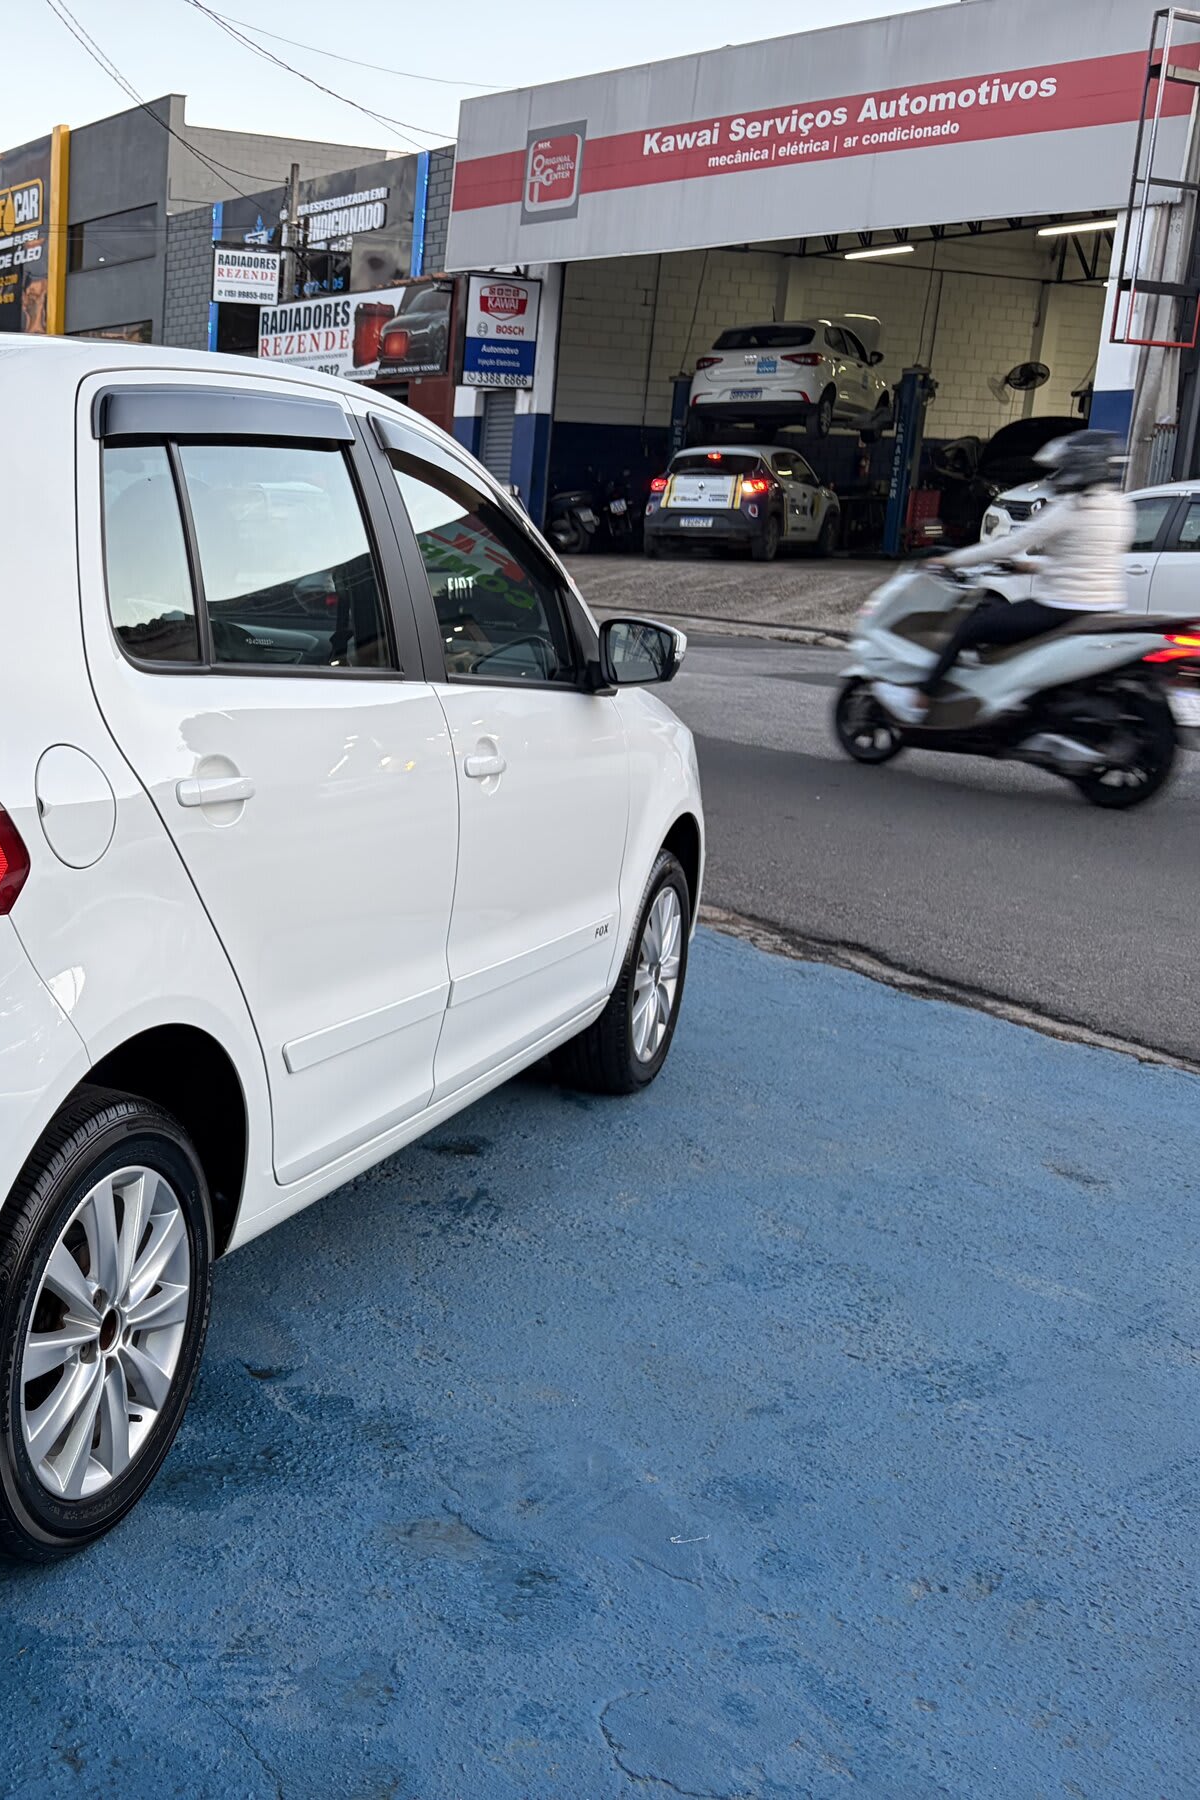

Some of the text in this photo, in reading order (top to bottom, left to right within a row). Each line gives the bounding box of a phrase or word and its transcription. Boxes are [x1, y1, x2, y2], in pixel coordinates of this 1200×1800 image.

[643, 77, 1057, 155] Kawai Serviços Automotivos
[708, 120, 960, 168] mecânica elétrica ar condicionado
[301, 202, 385, 244] NDICIONADO
[14, 246, 42, 266] ÓLEO
[218, 254, 277, 270] RADIADORES
[217, 267, 277, 281] REZENDE
[487, 298, 518, 310] KAWAI
[261, 300, 351, 336] RADIADORES
[496, 324, 525, 336] BOSCH
[260, 329, 351, 358] REZENDE
[594, 922, 609, 939] FOX
